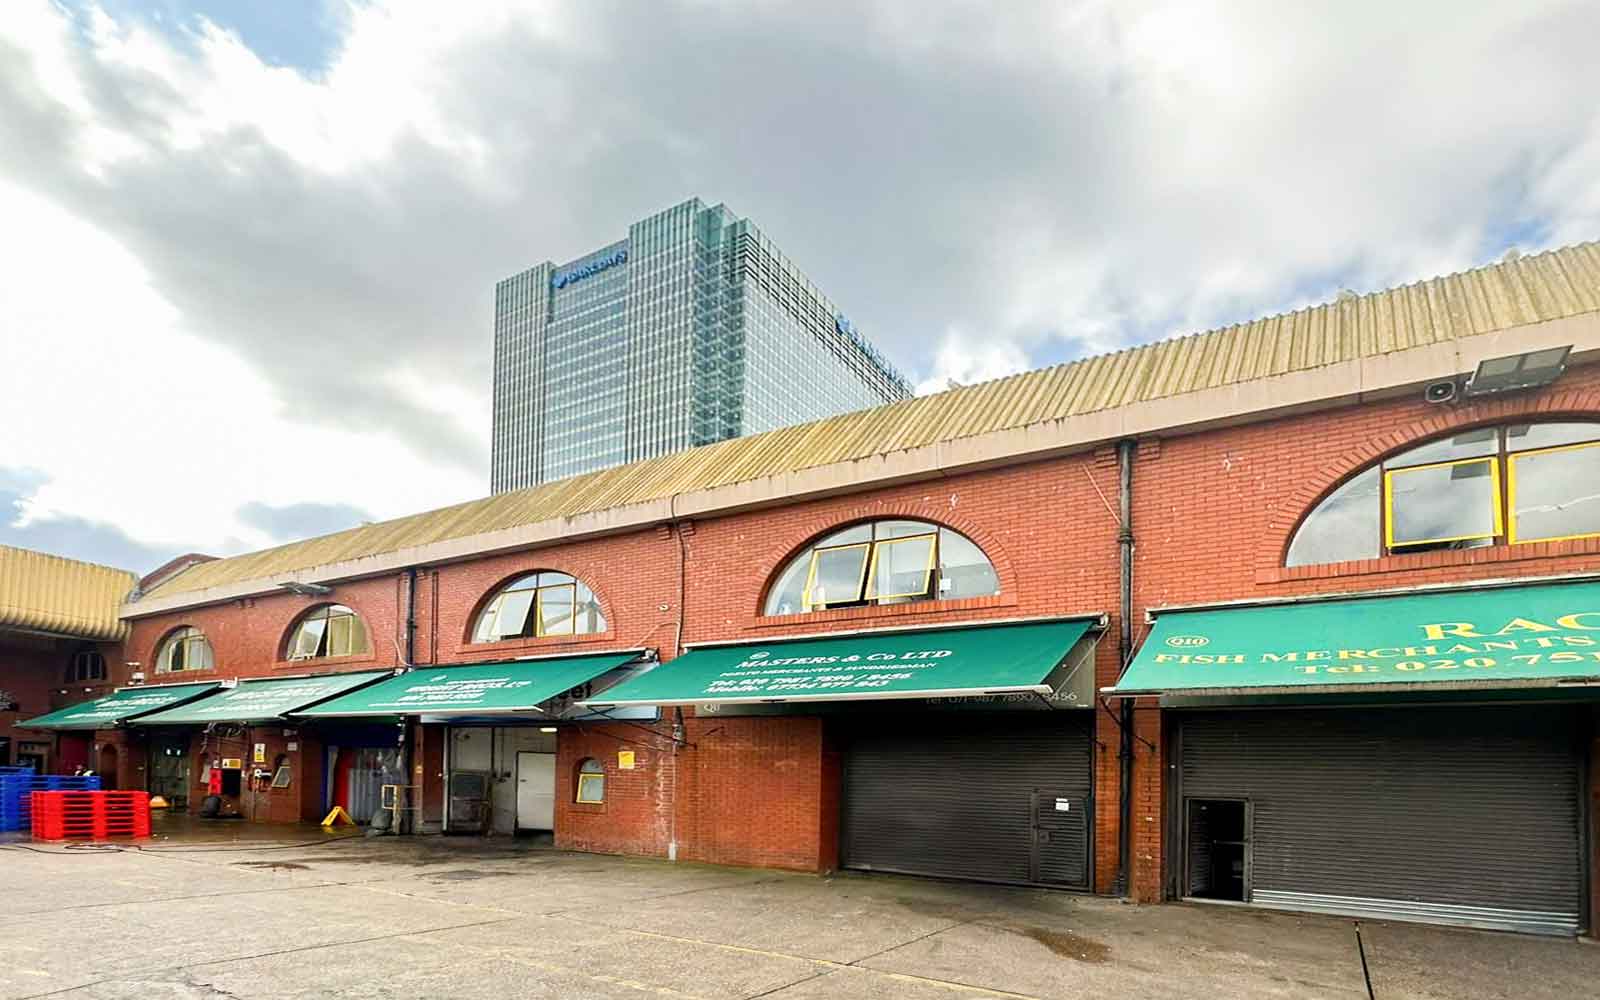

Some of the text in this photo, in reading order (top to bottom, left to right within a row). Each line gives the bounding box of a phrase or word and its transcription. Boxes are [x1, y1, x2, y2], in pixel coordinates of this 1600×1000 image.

[735, 655, 836, 668] MASTERS
[841, 654, 861, 662] &
[866, 653, 896, 661] Co
[900, 650, 953, 660] LTD
[1154, 636, 1597, 664] FISH MERCHANTS
[1295, 664, 1381, 674] Tel:
[1395, 657, 1496, 672] 020
